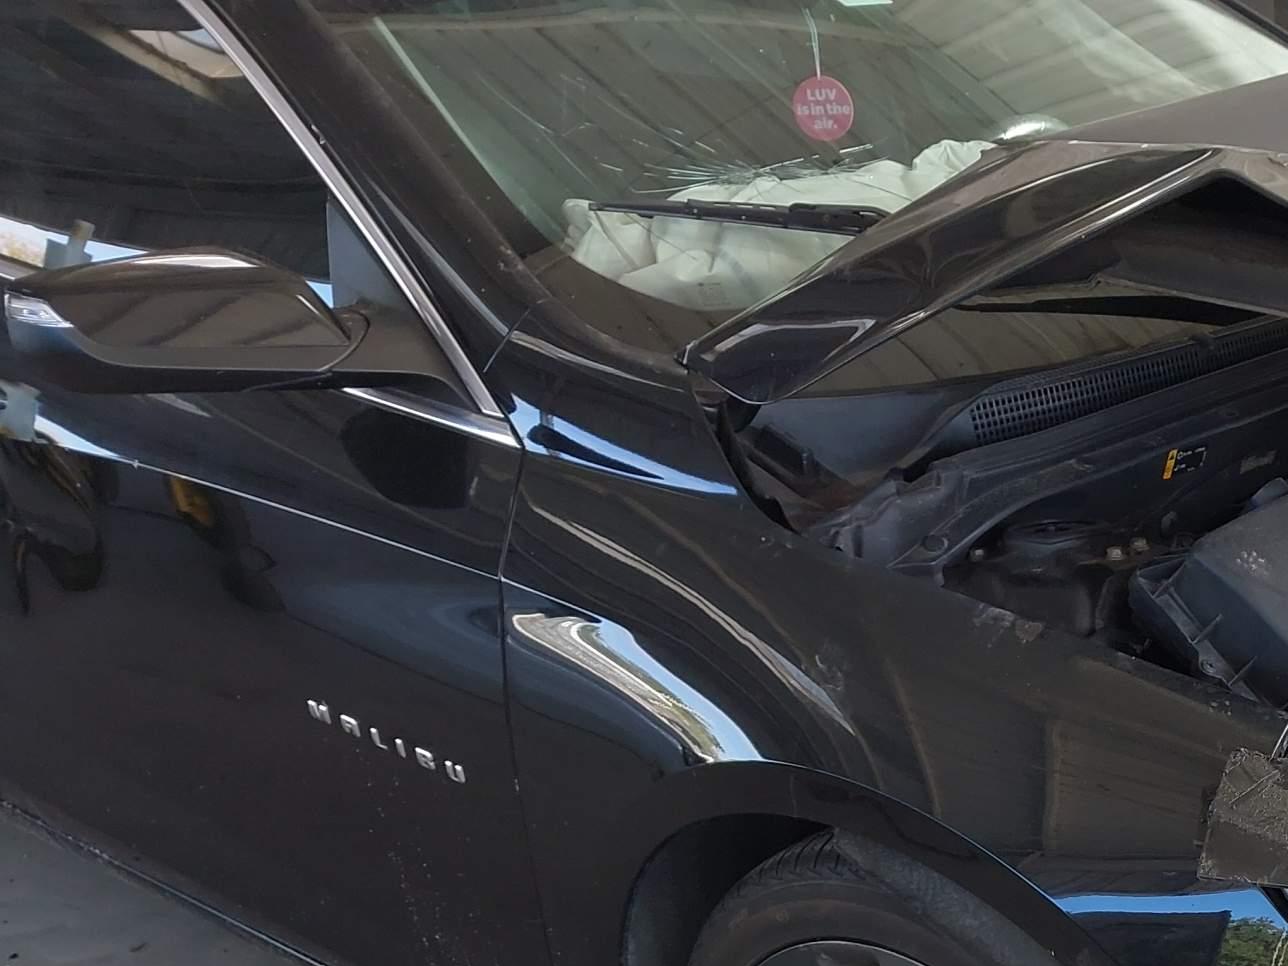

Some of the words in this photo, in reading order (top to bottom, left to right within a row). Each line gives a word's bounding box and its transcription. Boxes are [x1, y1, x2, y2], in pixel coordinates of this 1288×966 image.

[806, 88, 836, 101] LUV
[797, 104, 809, 115] is
[811, 103, 825, 115] in
[826, 103, 850, 115] the
[814, 117, 838, 129] air.
[307, 700, 466, 783] MALIBU
